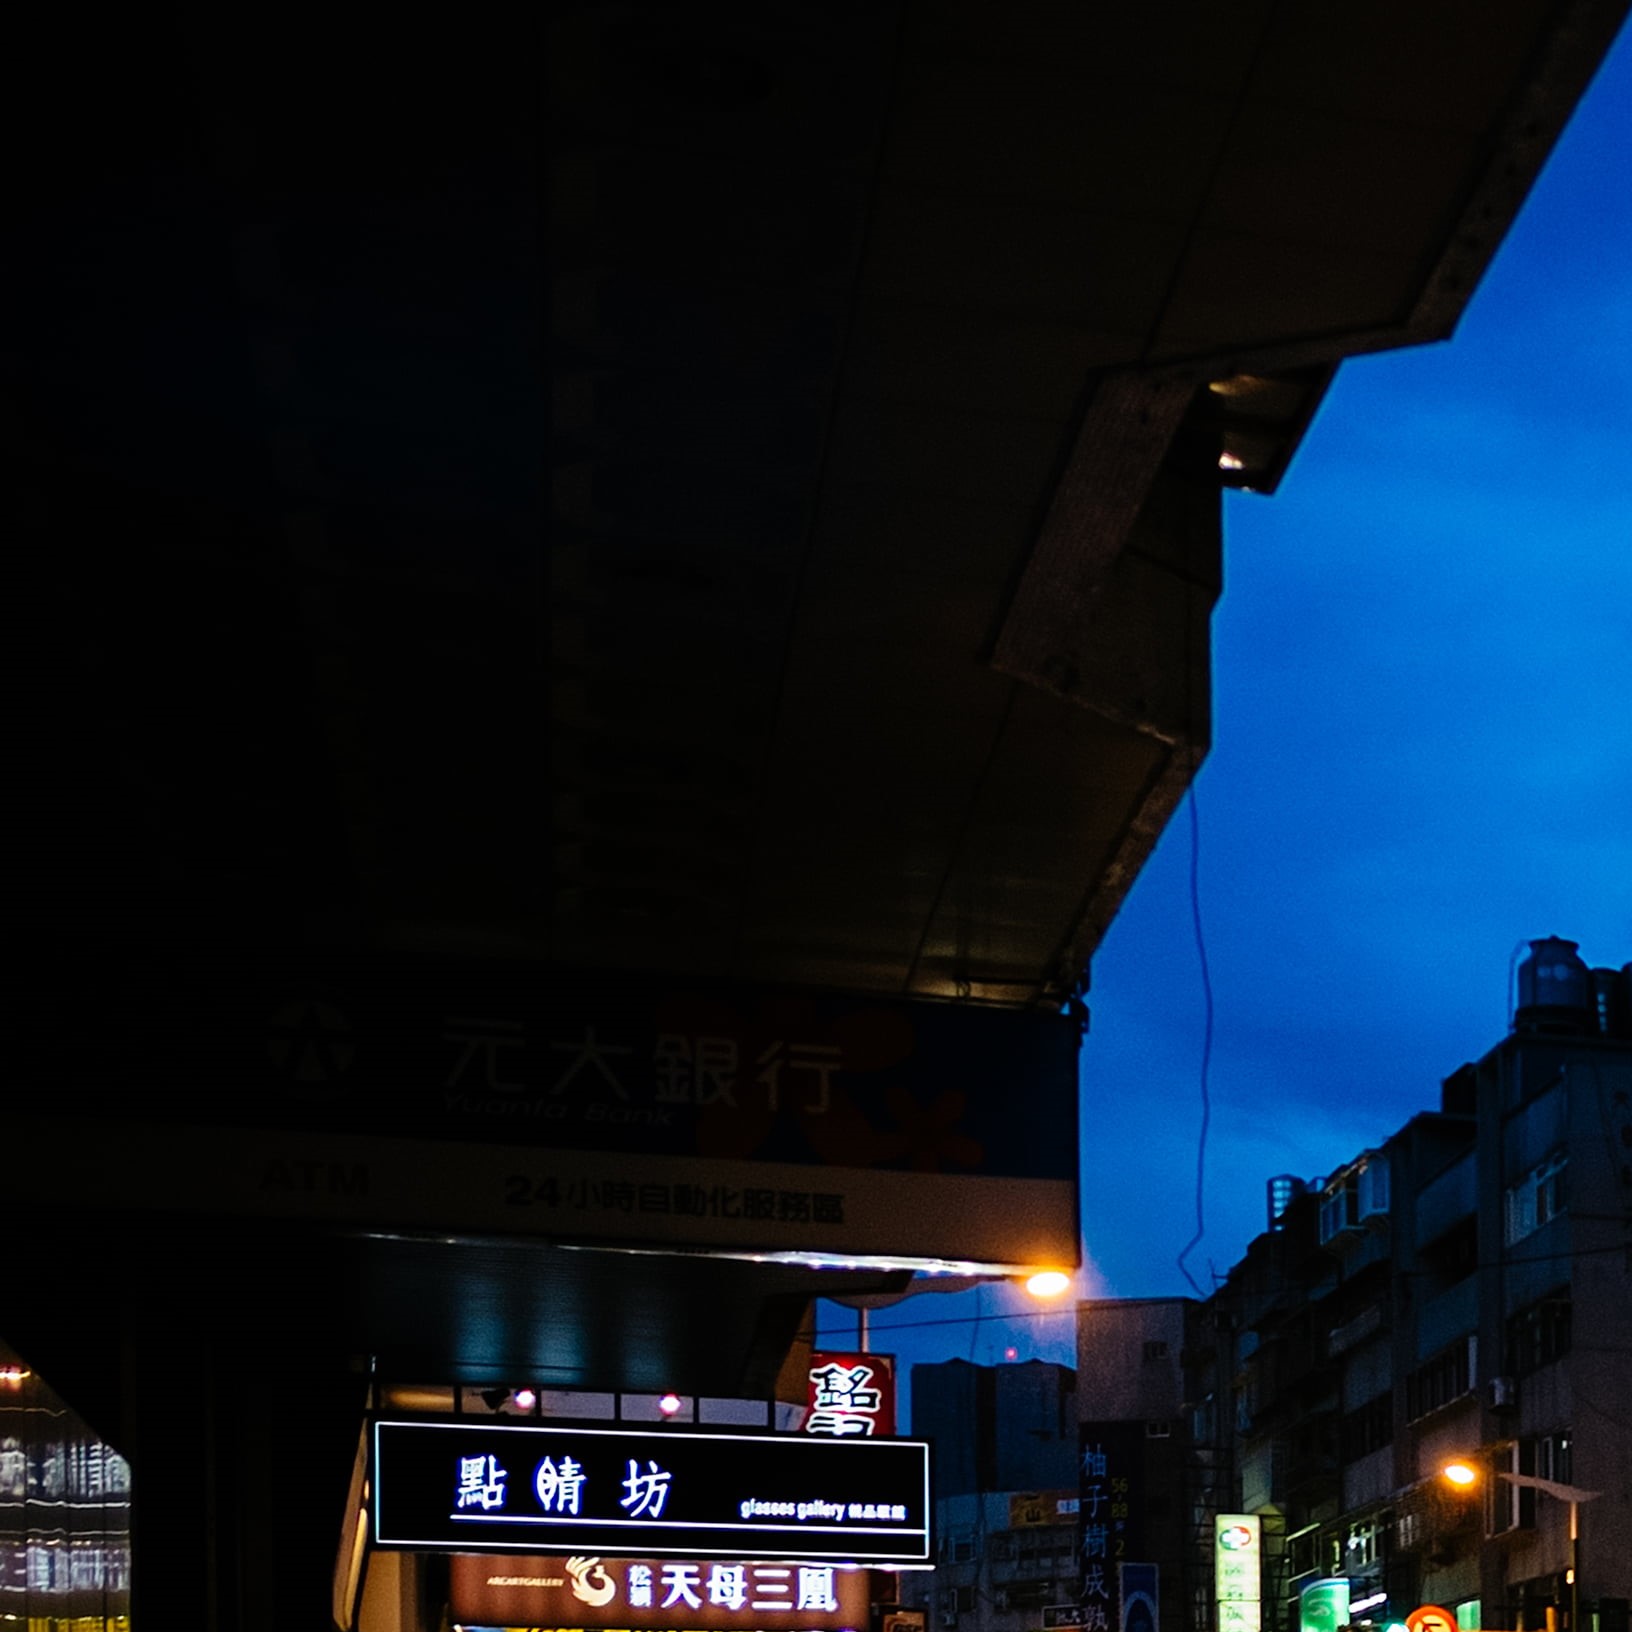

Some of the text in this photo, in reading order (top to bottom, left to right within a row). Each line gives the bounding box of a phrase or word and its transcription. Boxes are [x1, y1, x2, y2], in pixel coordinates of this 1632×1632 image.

[440, 1014, 845, 1117] 元大銀行
[258, 1158, 370, 1196] ATM
[741, 1498, 796, 1519] glasses
[797, 1500, 846, 1521] gallery
